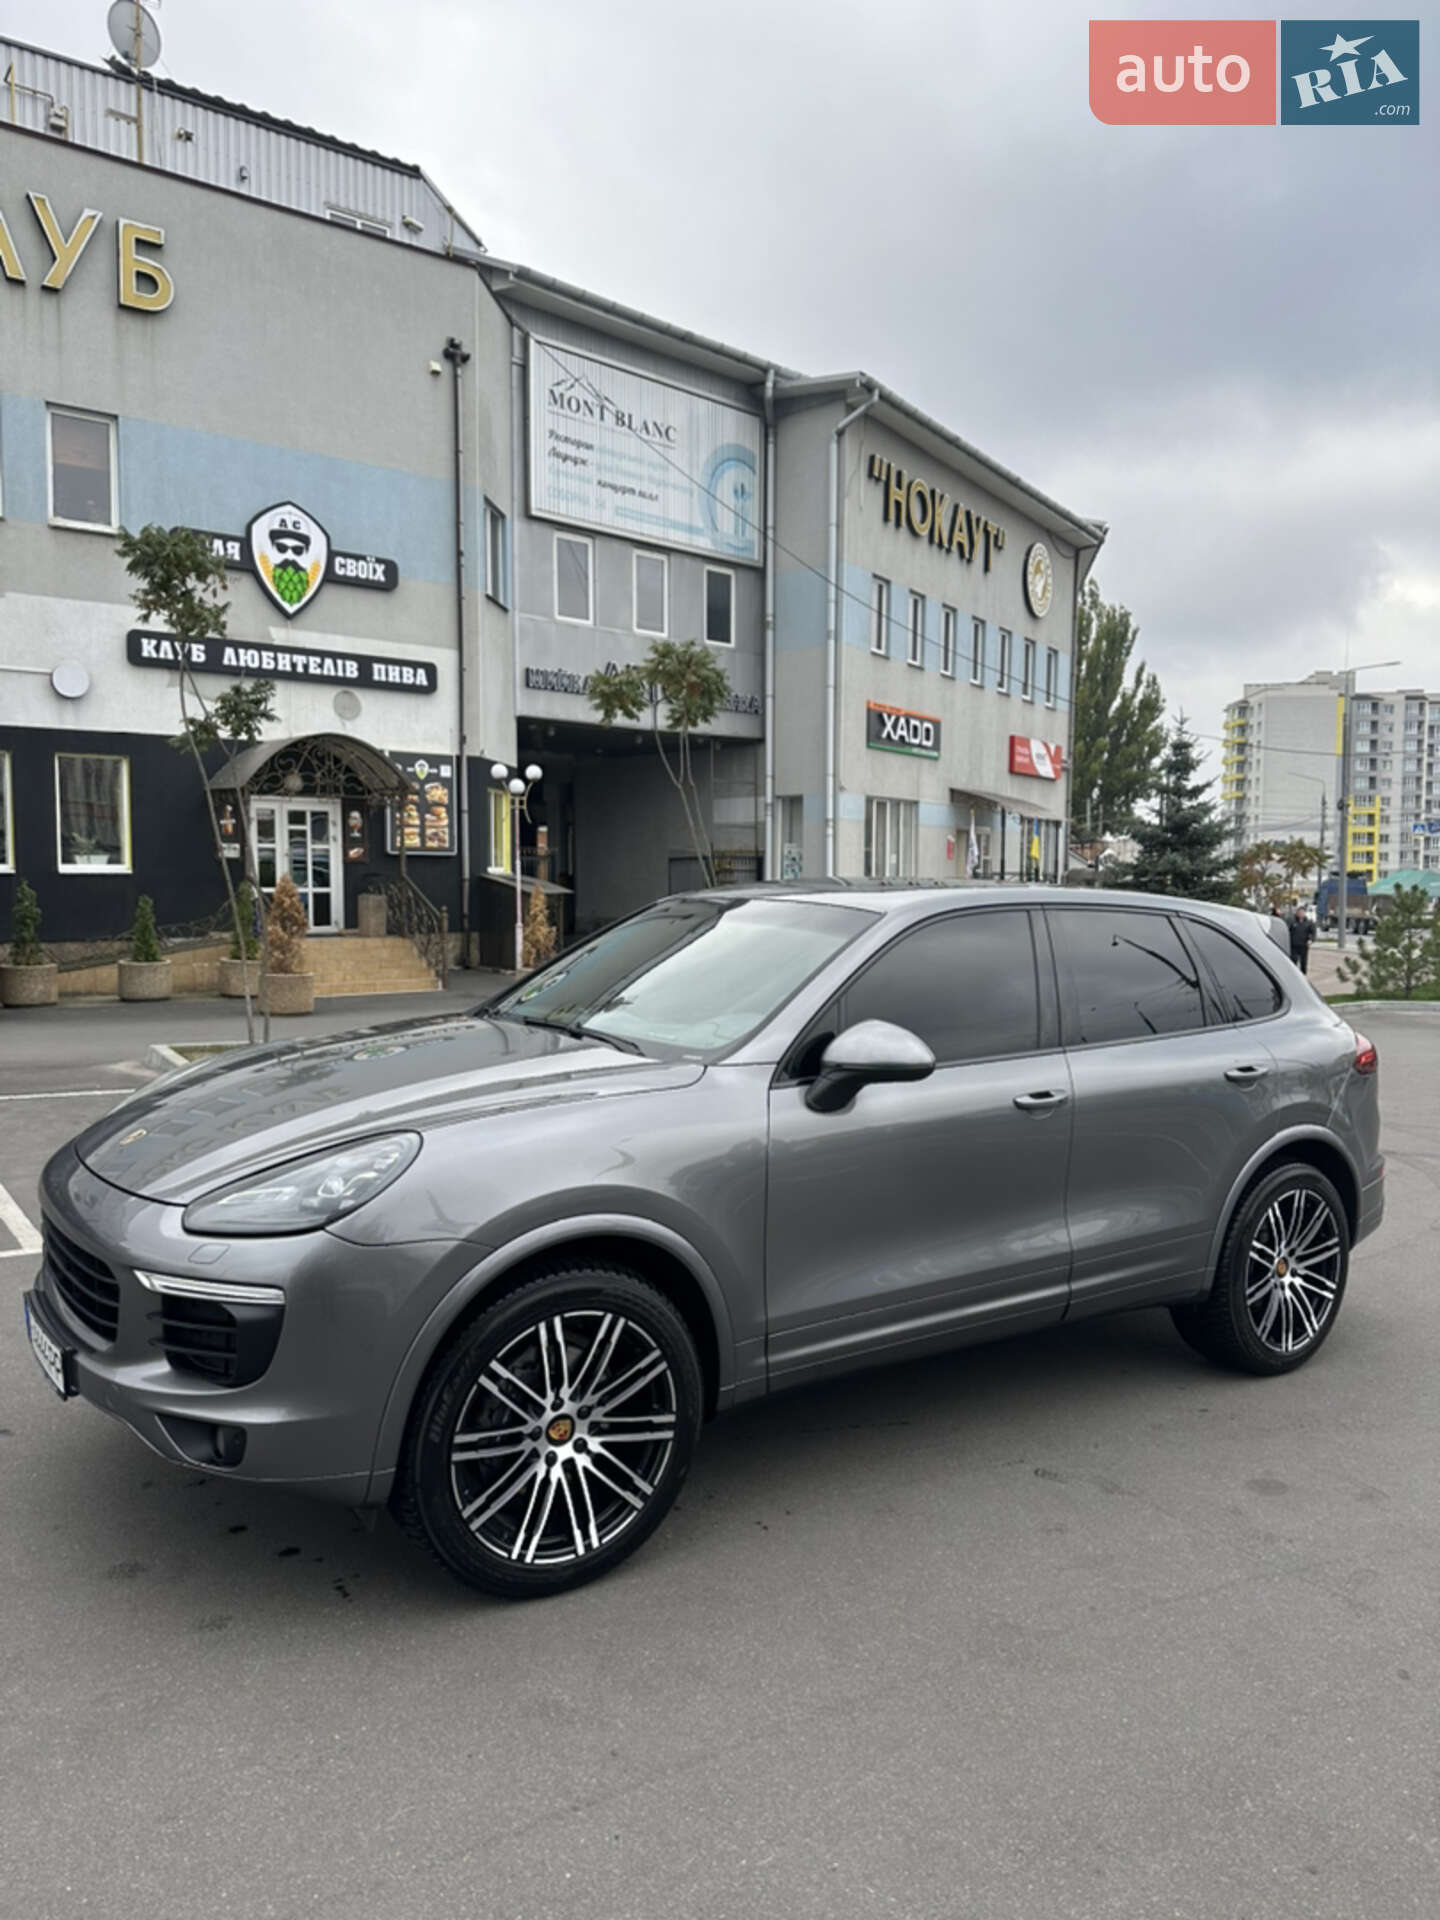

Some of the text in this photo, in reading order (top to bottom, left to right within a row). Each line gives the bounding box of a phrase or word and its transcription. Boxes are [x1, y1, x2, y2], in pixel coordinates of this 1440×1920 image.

[548, 388, 678, 443] MONT BLANC
[334, 555, 386, 583] СВОЇХ
[141, 637, 429, 687] КЛУБ ЛЮБИТЕЛІВ ПИВА
[881, 711, 935, 748] XADO
